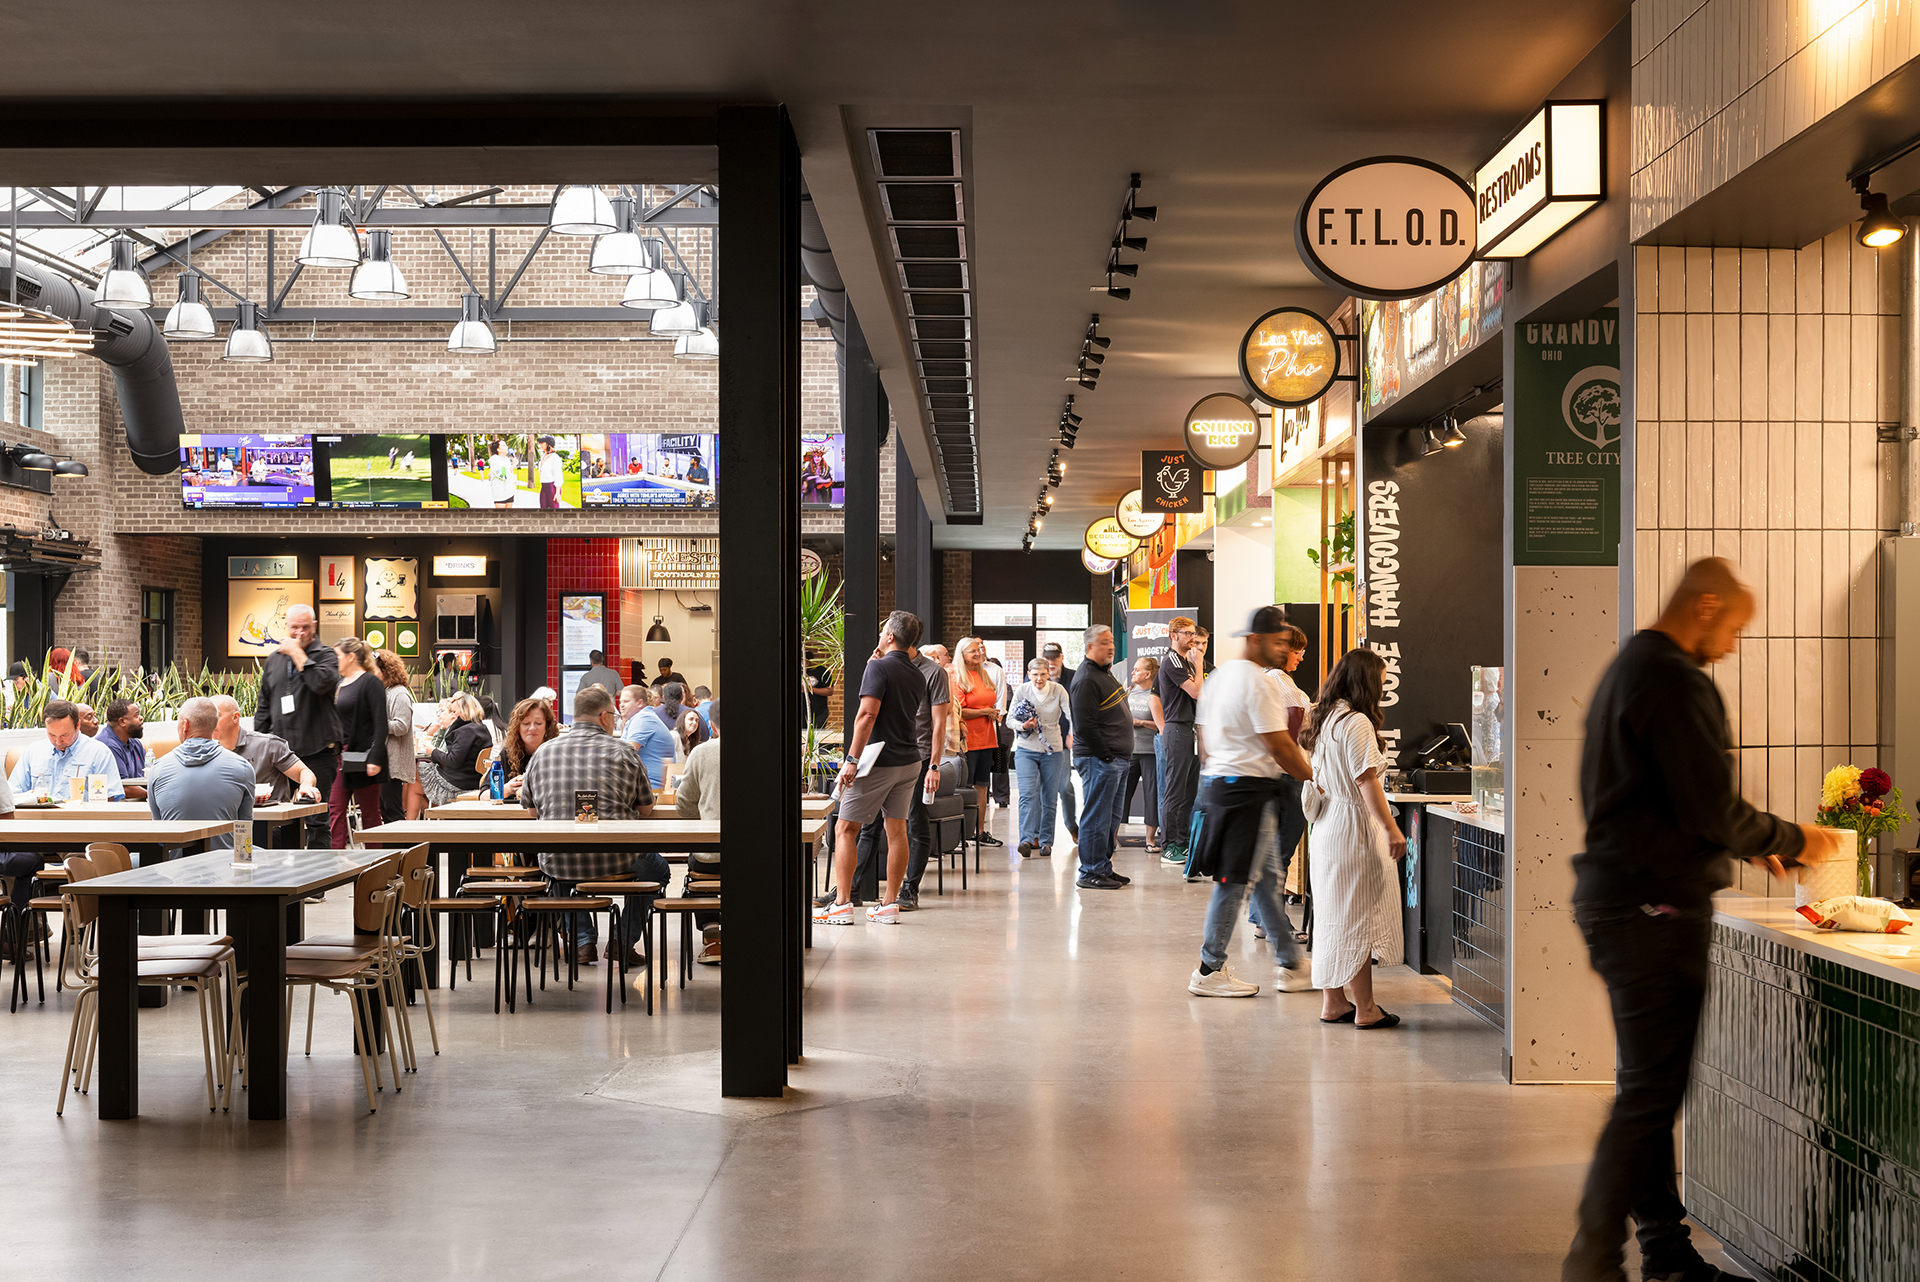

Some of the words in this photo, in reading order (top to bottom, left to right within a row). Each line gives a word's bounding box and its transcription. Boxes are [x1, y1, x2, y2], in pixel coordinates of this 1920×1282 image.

[1479, 141, 1541, 224] RESTROOMS
[1318, 208, 1466, 246] F.T.L.O.D.
[1259, 331, 1287, 346] Lan
[1291, 330, 1323, 346] Viet
[1526, 319, 1620, 345] GRANDV
[1541, 350, 1562, 361] OHIO
[1262, 348, 1322, 384] Pho
[1191, 421, 1253, 433] COMMON
[663, 435, 696, 448] FACILITY
[1208, 434, 1238, 445] RICE
[1160, 454, 1185, 464] JUST
[1546, 451, 1584, 465] TREE
[1586, 451, 1621, 465] CITY
[1155, 496, 1189, 508] CHICKEN
[1368, 480, 1401, 628] HANGOVERS
[1137, 646, 1169, 657] NUGGETS
